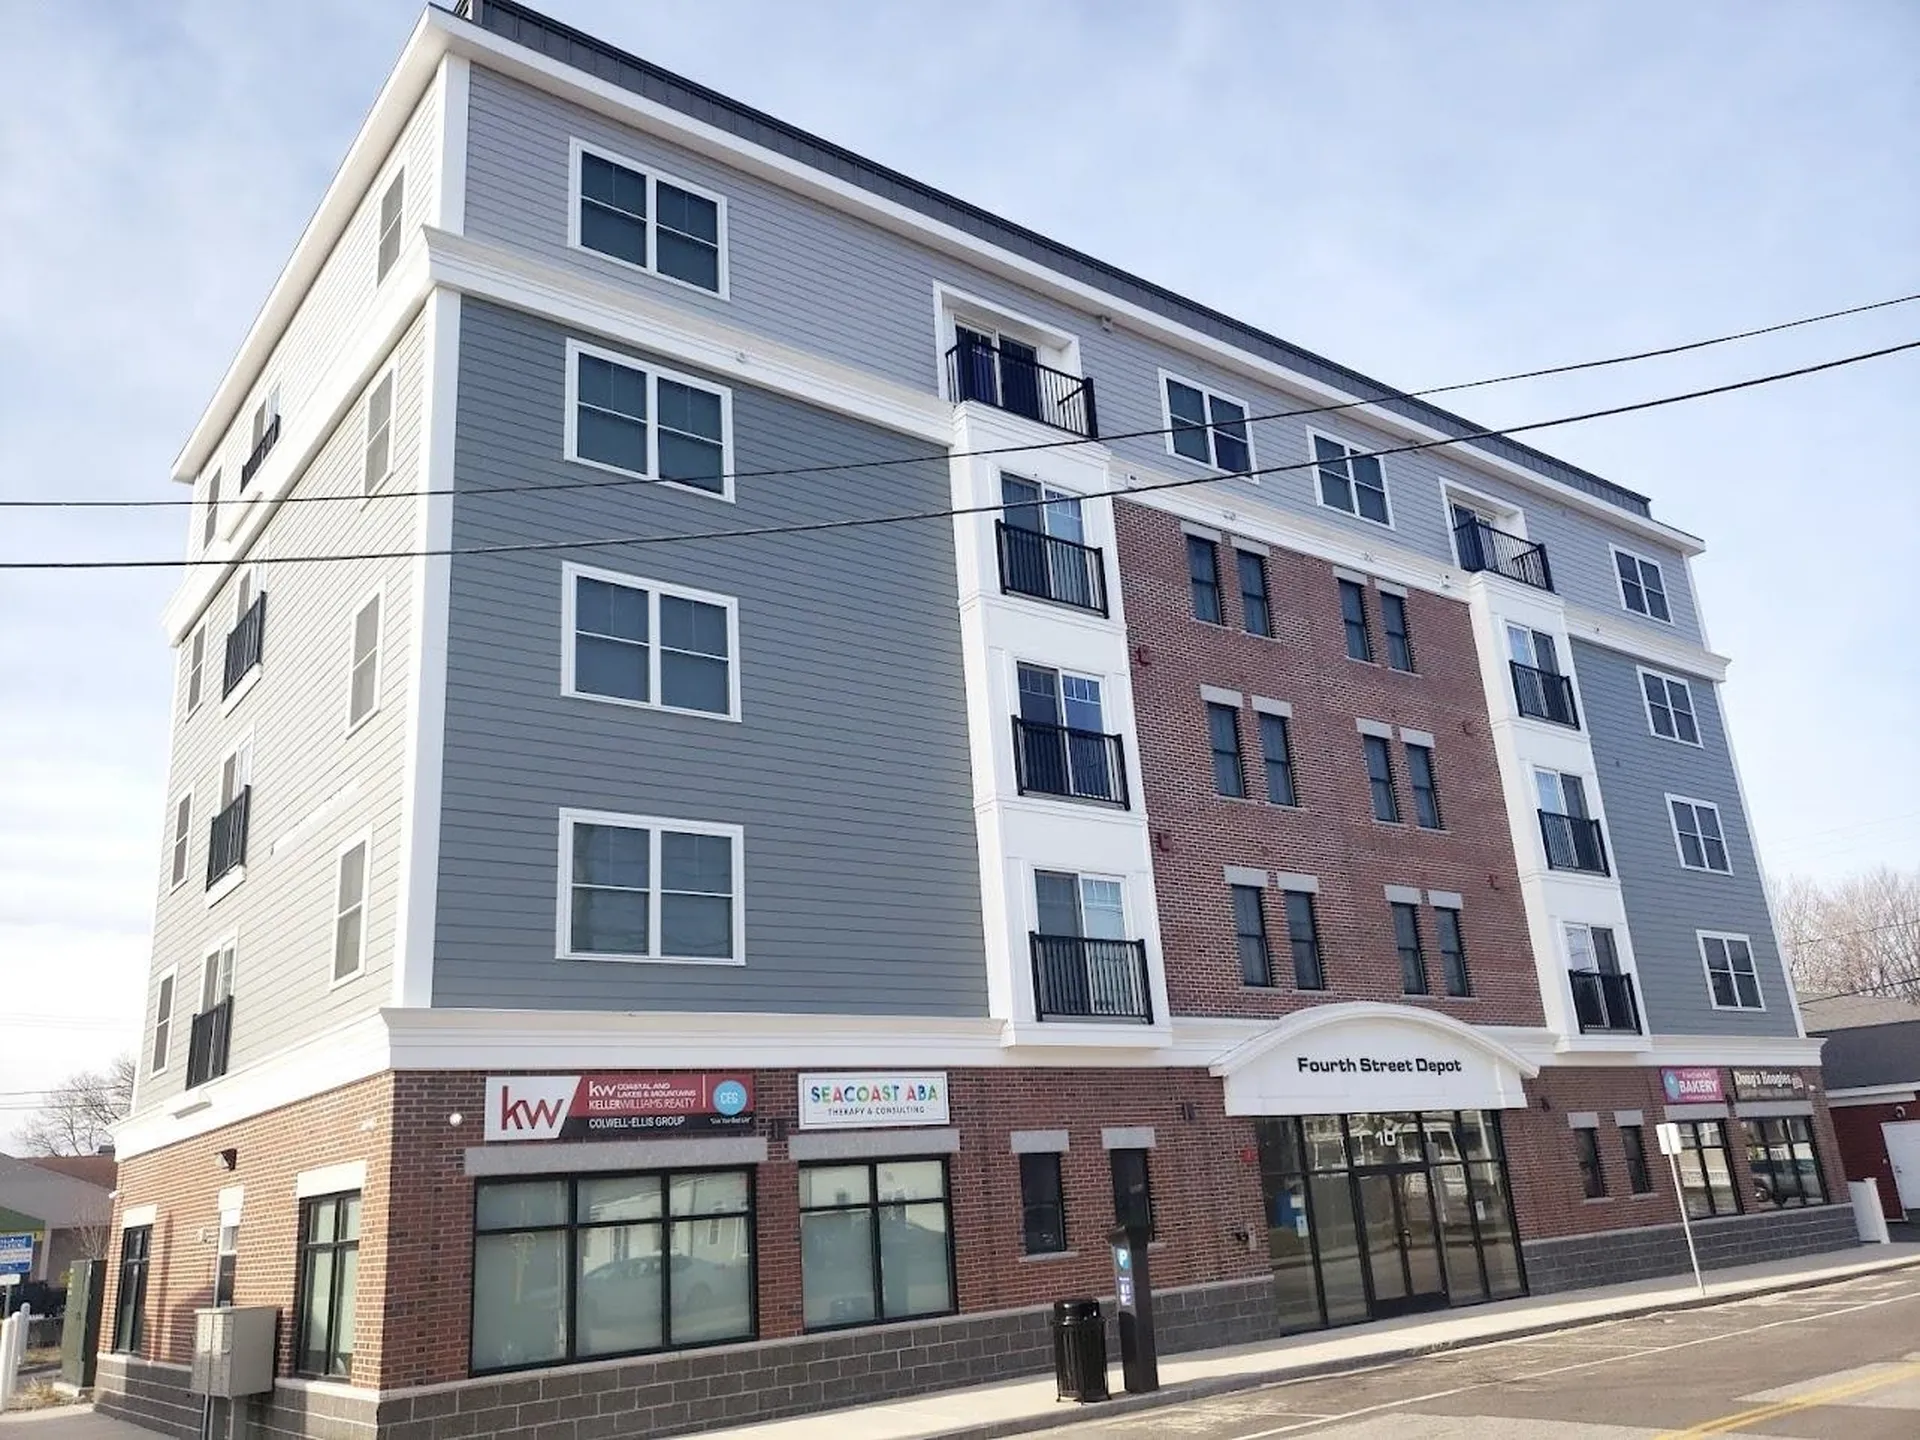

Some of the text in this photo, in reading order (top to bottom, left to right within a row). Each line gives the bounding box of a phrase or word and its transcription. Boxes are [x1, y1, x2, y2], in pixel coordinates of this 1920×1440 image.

[1297, 1057, 1462, 1076] Fourth Street Depot
[588, 1080, 617, 1098] kw
[652, 1082, 671, 1090] AND
[811, 1083, 938, 1103] SEACOAST ABA
[1678, 1079, 1718, 1093] BAKERY
[617, 1090, 642, 1098] LAKES
[501, 1085, 565, 1131] kw
[663, 1097, 697, 1109] REALTY
[828, 1105, 925, 1117] THERAPY & CONSULTING
[588, 1115, 685, 1129] COLWELL-ELLIS GROUP
[1375, 1130, 1397, 1147] 10
